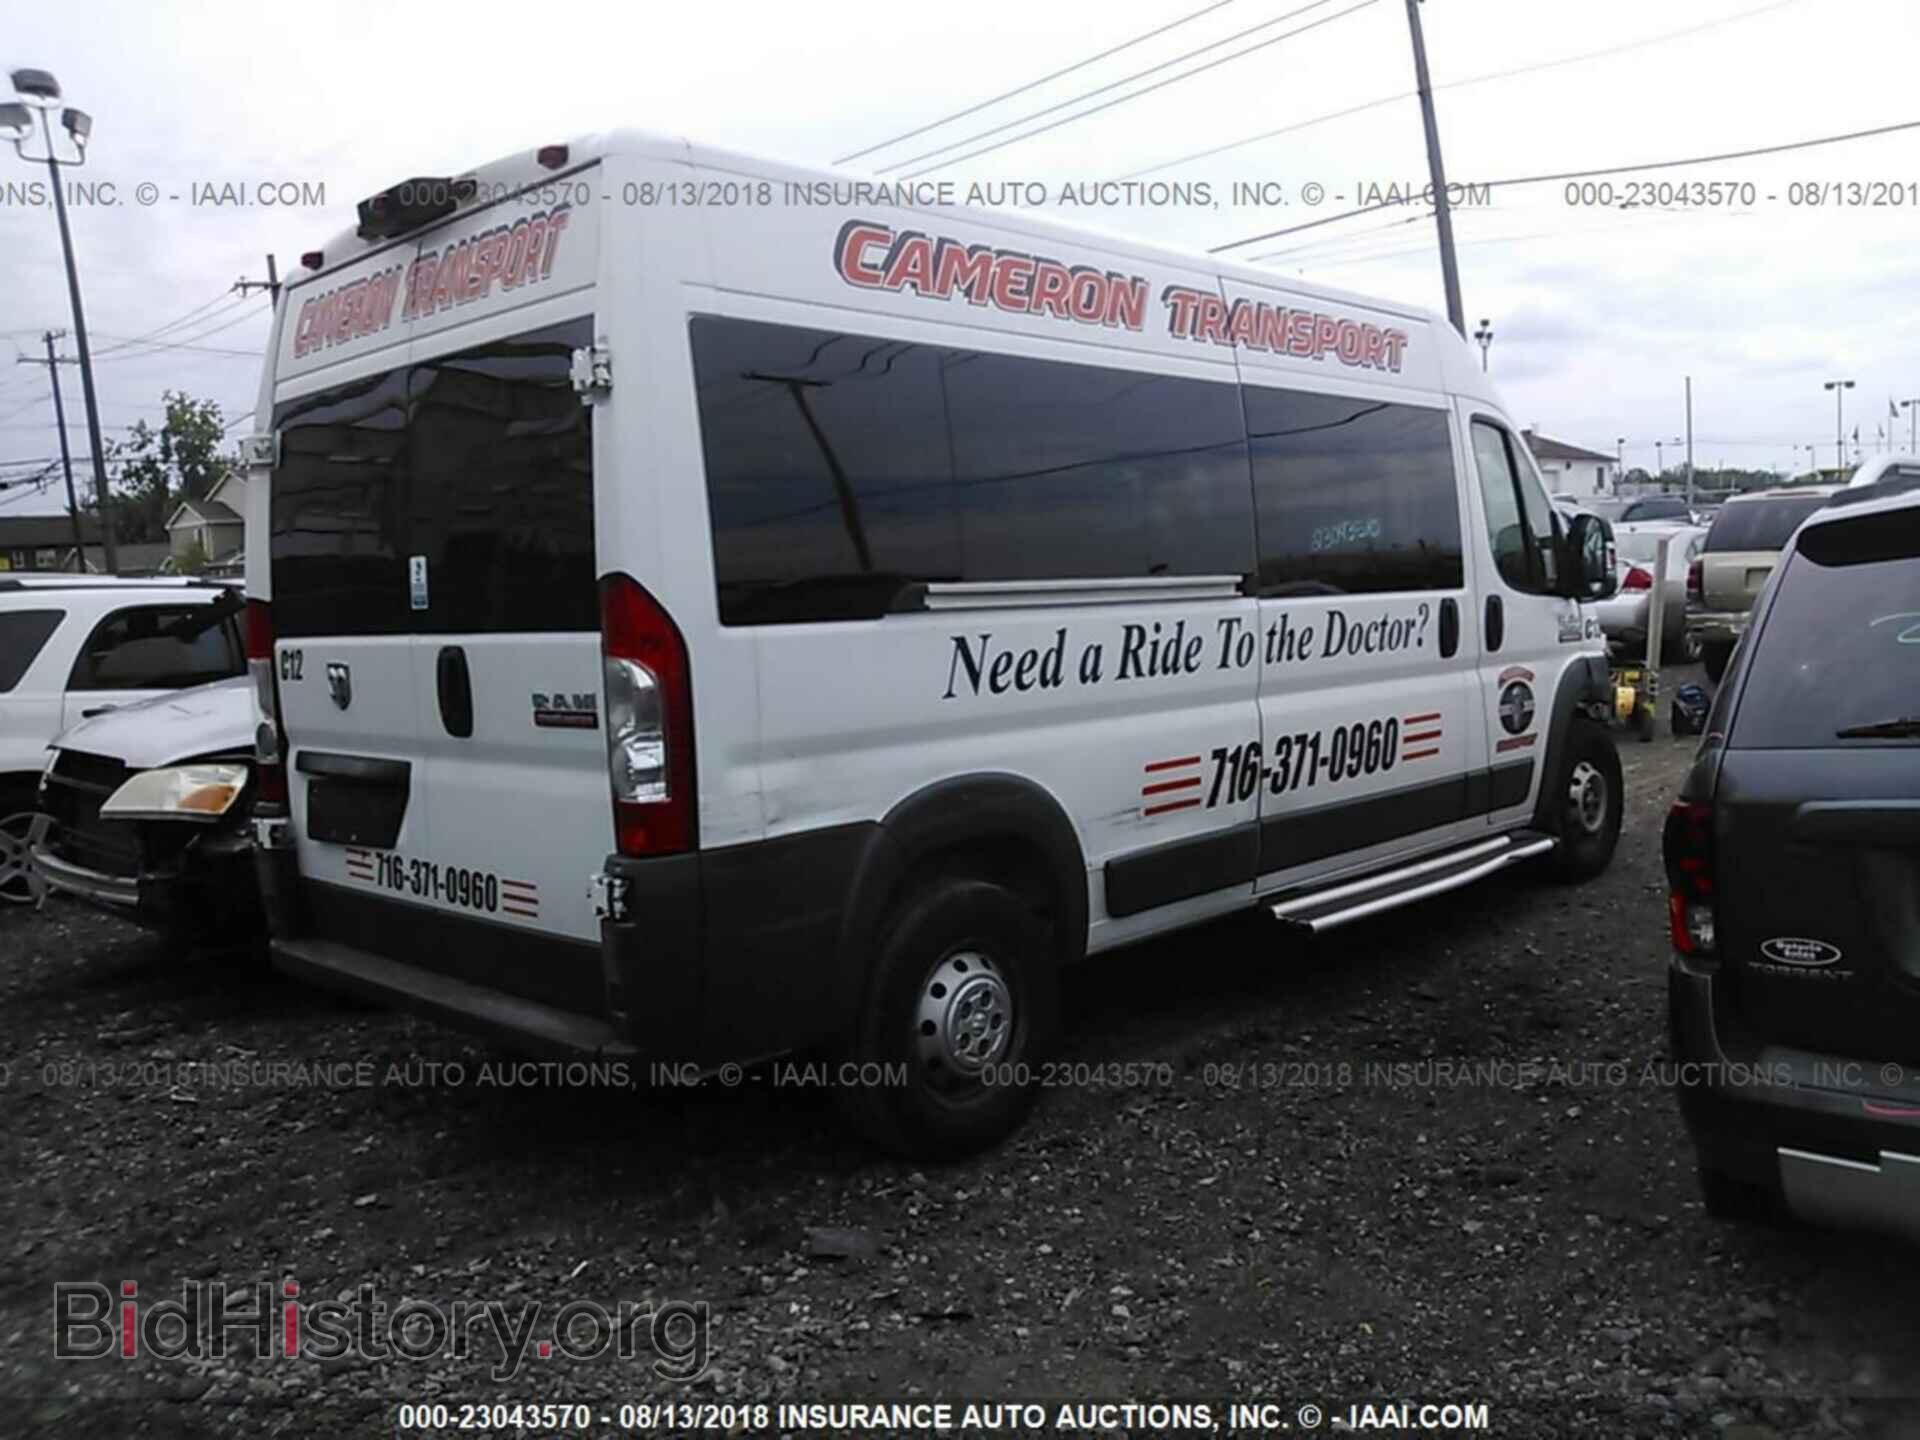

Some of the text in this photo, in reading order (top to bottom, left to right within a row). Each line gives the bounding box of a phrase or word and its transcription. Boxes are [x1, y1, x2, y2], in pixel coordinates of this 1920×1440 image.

[294, 201, 571, 360] CAMERON TRANSPORT
[833, 219, 1408, 374] CAMERON TRANSPORT
[281, 649, 304, 681] C12
[942, 602, 1430, 700] Need a Ride To the Doctor?
[531, 693, 597, 710] RAM
[1206, 716, 1399, 808] 716-371-0960
[375, 851, 498, 912] 716-371-0960
